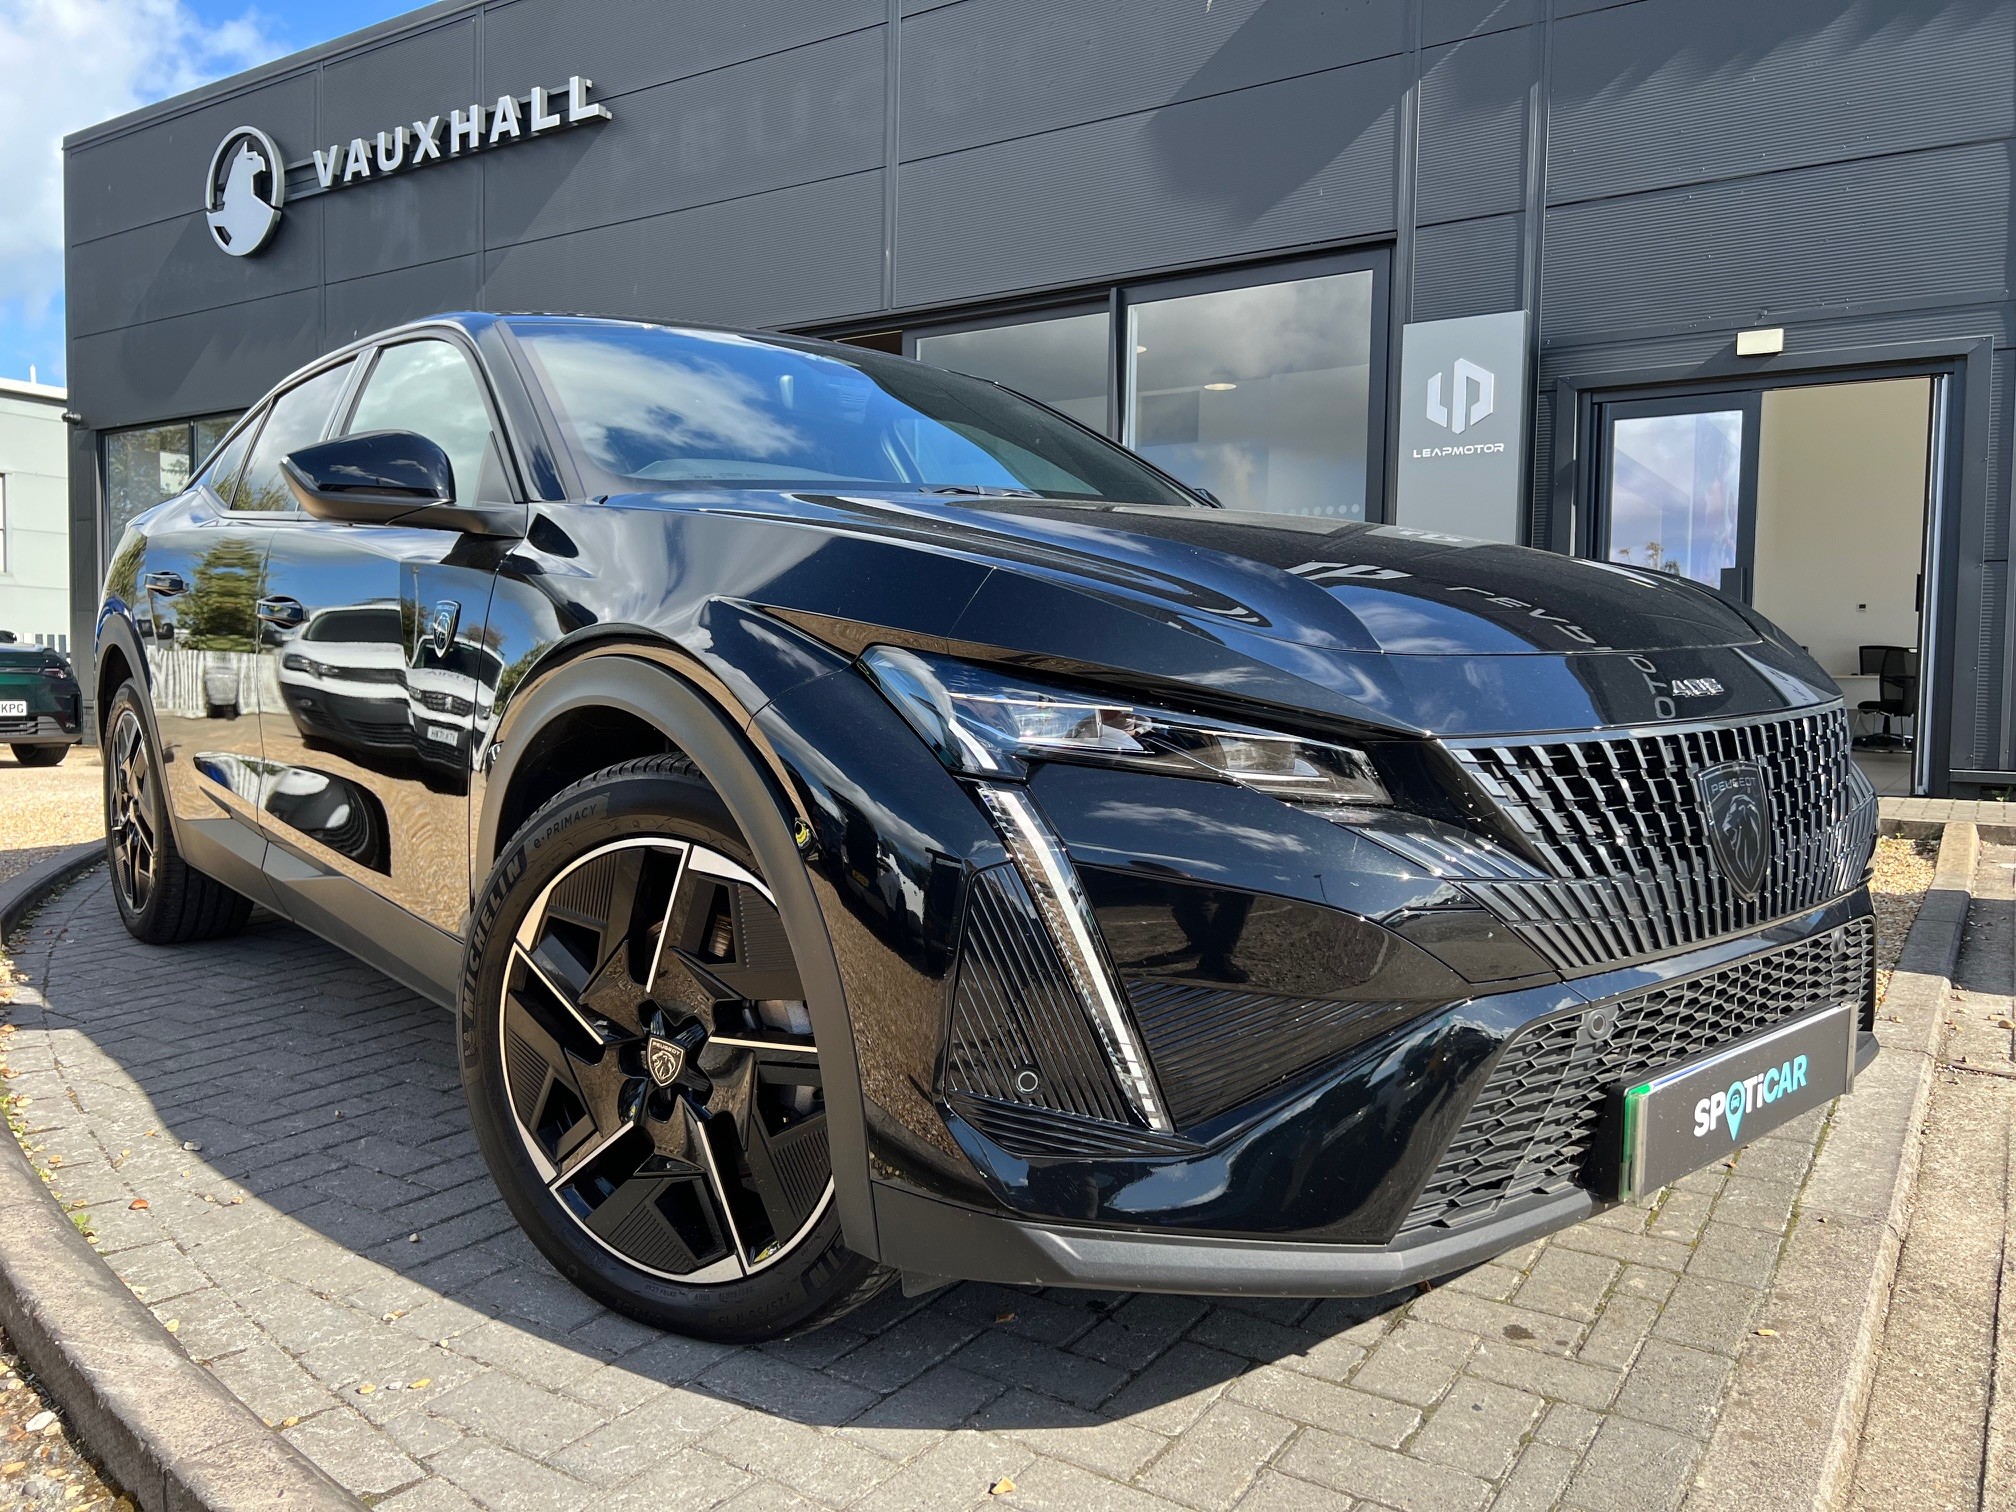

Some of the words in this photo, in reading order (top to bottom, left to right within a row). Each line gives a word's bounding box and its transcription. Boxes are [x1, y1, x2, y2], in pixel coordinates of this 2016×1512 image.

[313, 75, 612, 189] VAUXHALL
[1413, 443, 1504, 458] LEAPMOTOR
[1, 703, 24, 713] KPG
[1710, 776, 1757, 795] PEUGEOT
[463, 856, 522, 1020] MICHELIN
[652, 1041, 681, 1056] PEUGEOT
